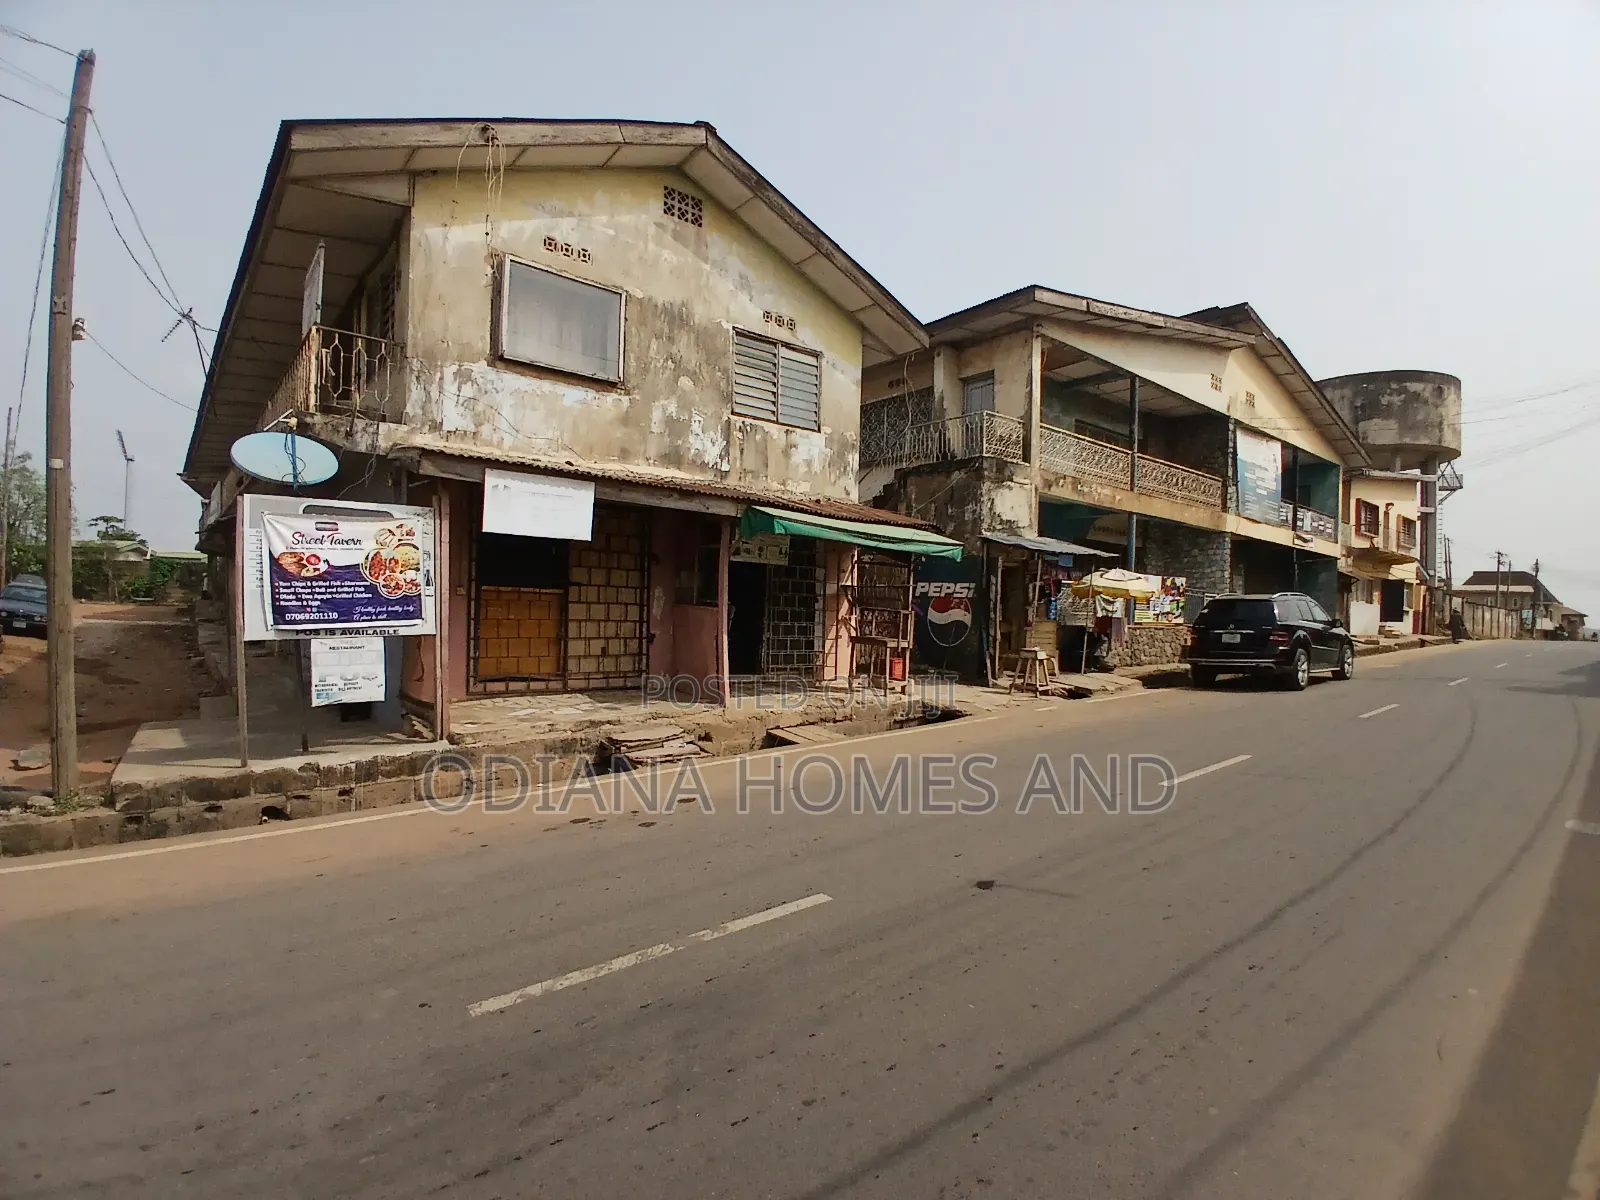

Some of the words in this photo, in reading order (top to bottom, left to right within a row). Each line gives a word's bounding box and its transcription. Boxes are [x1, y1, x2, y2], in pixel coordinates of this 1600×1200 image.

[291, 531, 326, 546] Street
[326, 532, 363, 546] Tavern
[285, 612, 338, 621] 07069201110
[339, 628, 400, 637] AVAILABLE
